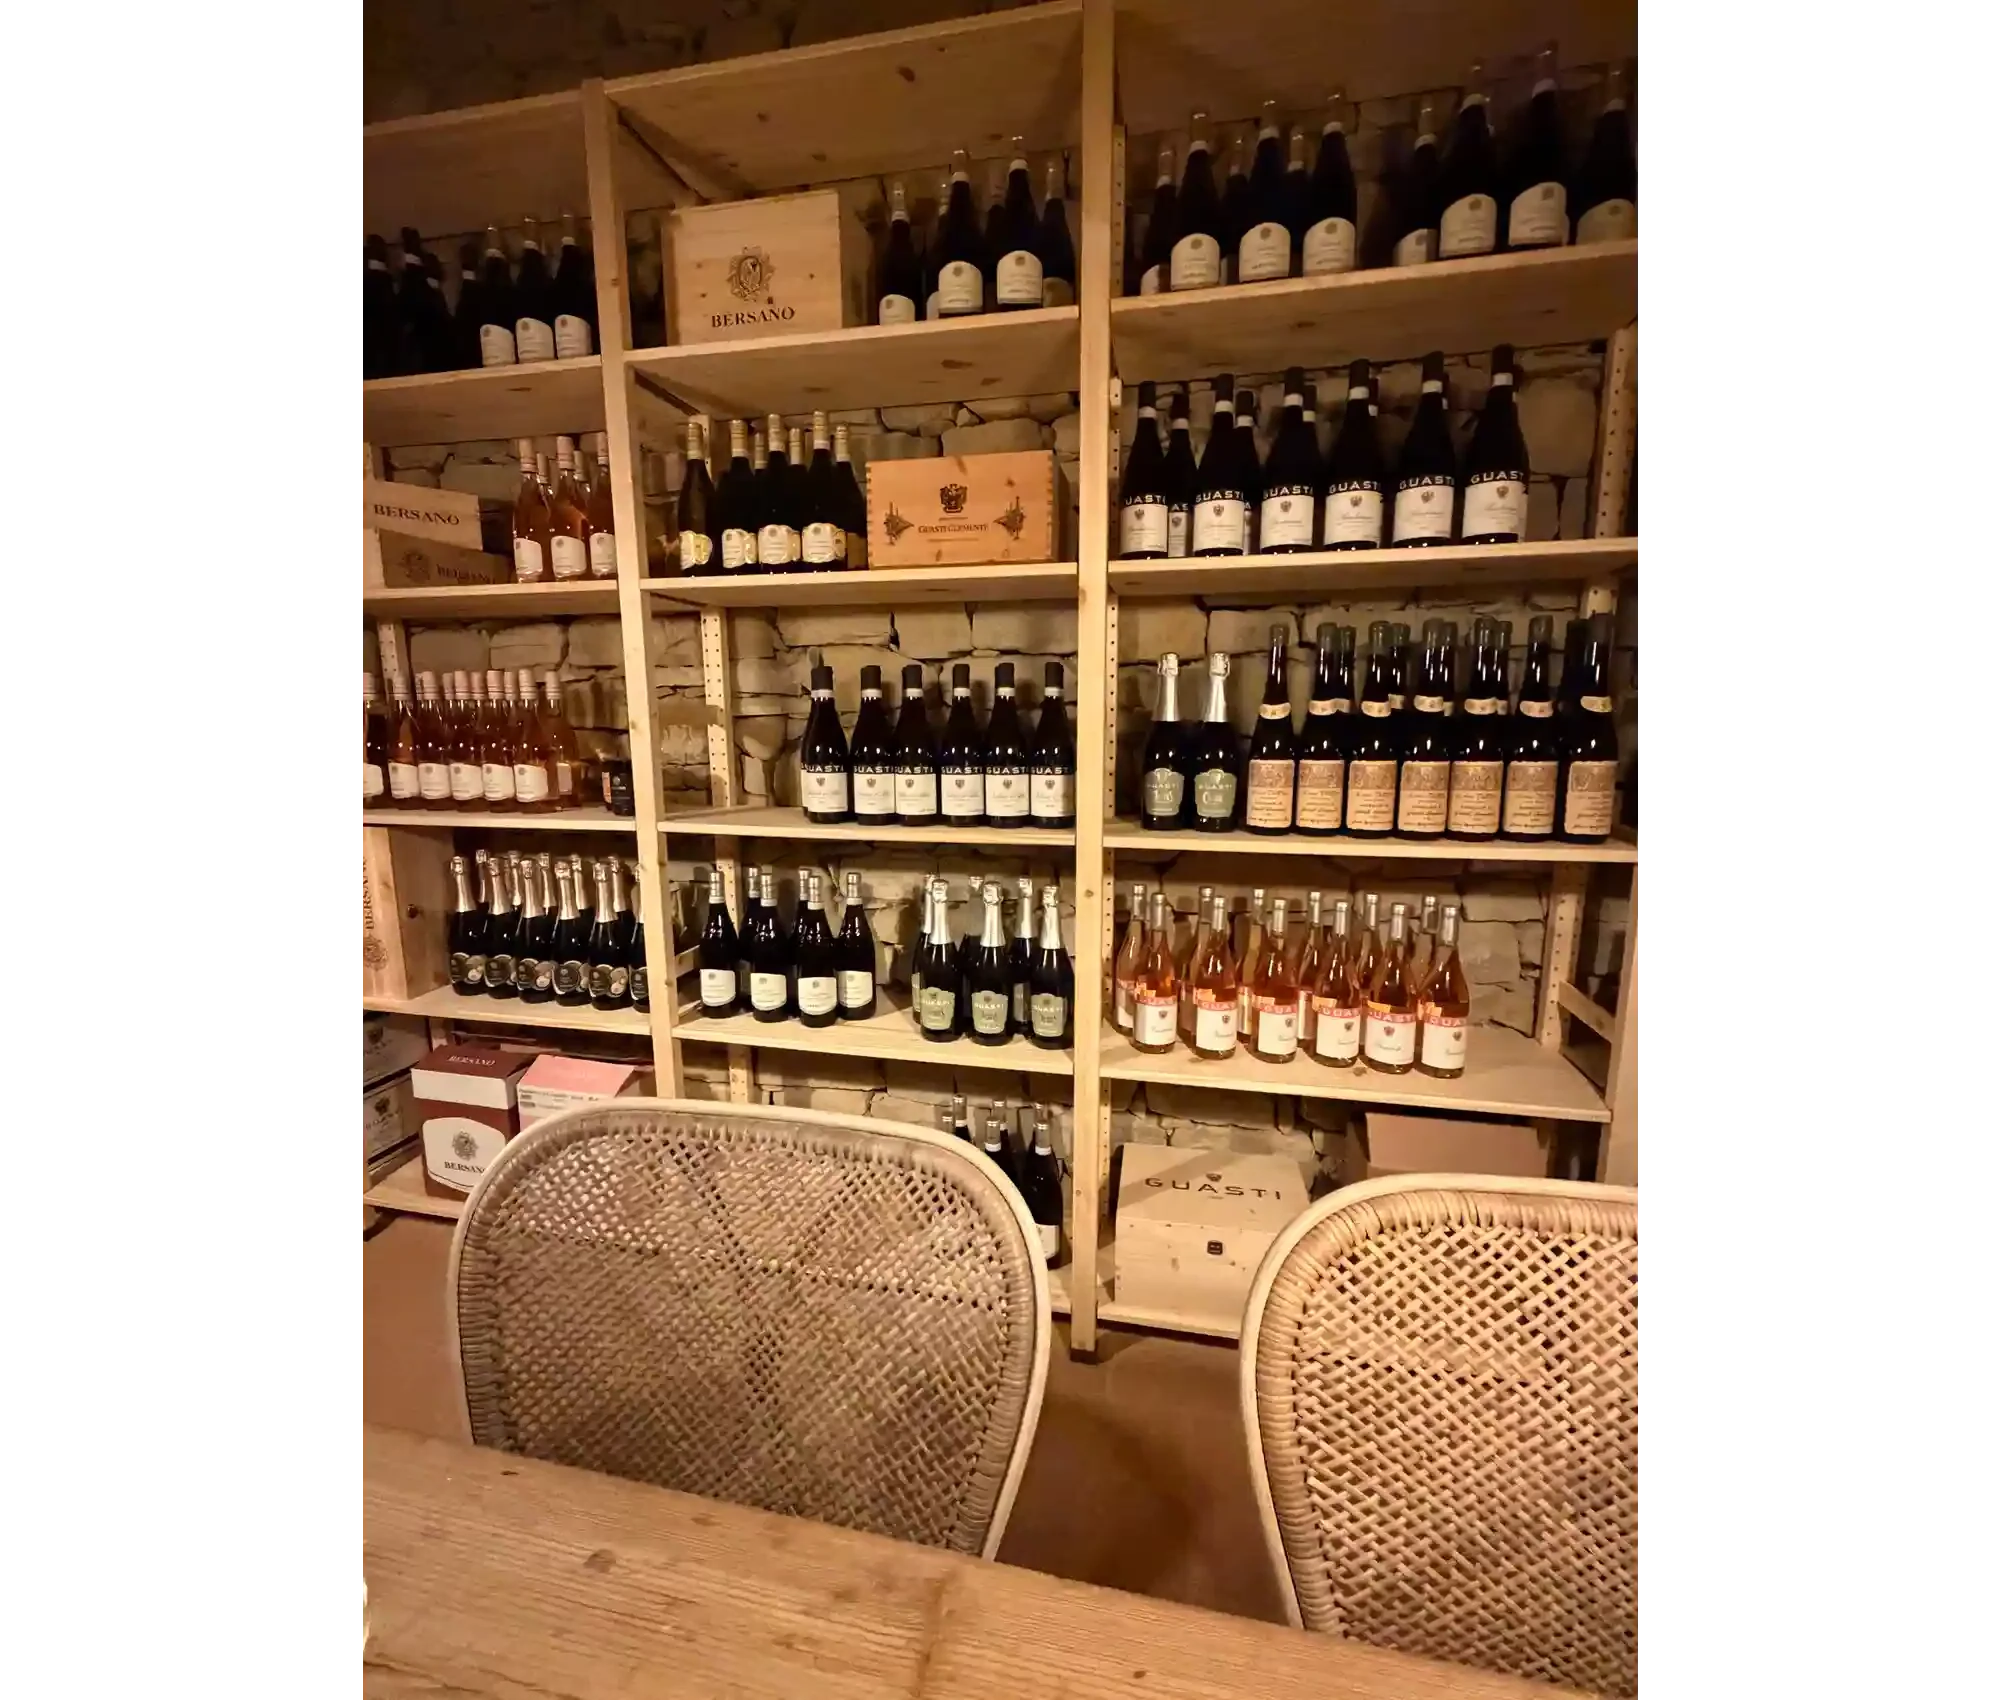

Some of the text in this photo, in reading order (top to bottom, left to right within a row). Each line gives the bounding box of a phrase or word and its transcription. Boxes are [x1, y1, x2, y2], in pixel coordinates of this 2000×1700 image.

[711, 306, 796, 328] BERSANO
[1470, 470, 1525, 485] GUAST
[1328, 480, 1379, 494] GUAST
[1125, 494, 1166, 506] UASTI
[373, 504, 460, 526] BERSANO
[444, 1161, 486, 1174] BERSAN
[1144, 1177, 1281, 1200] GUASTI
